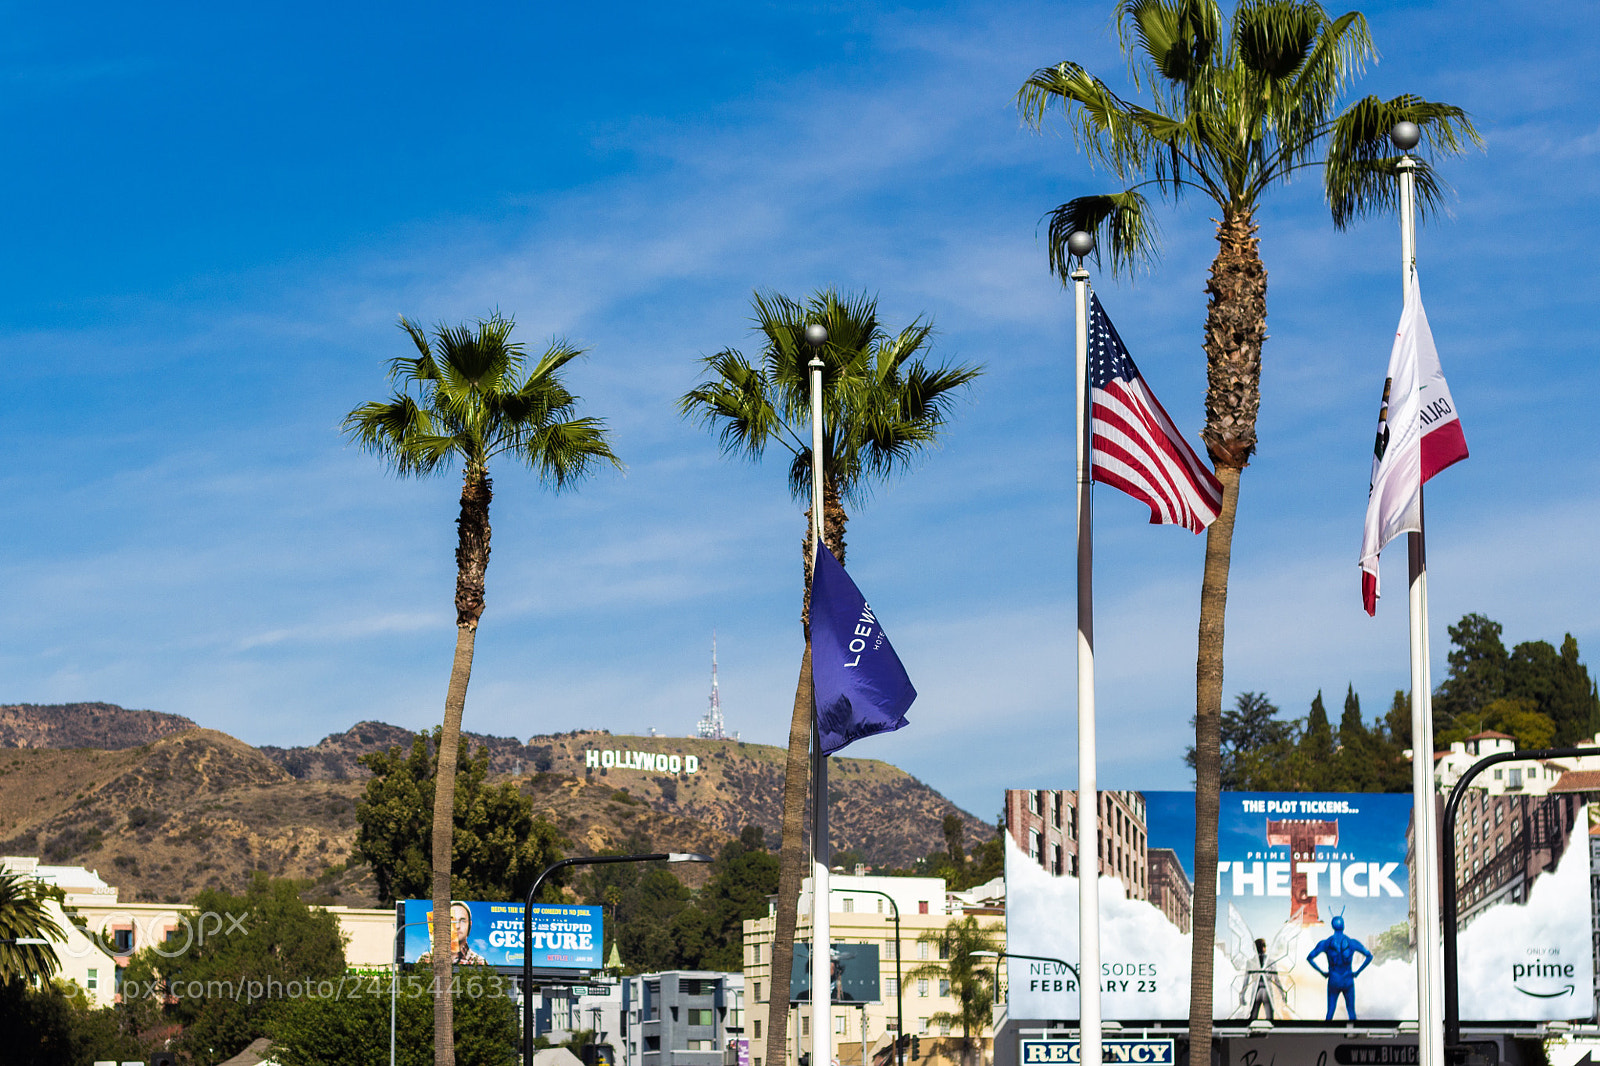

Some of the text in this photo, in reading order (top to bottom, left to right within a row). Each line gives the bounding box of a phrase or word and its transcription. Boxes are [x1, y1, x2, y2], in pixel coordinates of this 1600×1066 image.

[586, 749, 699, 774] HOLLYWOOD
[1242, 800, 1359, 814] THE PLOT TICKENS...
[1247, 851, 1355, 861] PRIME ORIGINAL
[1295, 861, 1405, 898] TICK
[508, 906, 518, 914] THE
[496, 920, 537, 931] FUTIE
[550, 922, 592, 933] STUPID
[1526, 947, 1561, 956] ONLY ON
[1030, 963, 1157, 977] NEW ESODES
[1512, 958, 1575, 982] prime
[1030, 980, 1157, 993] FEBRRY 23
